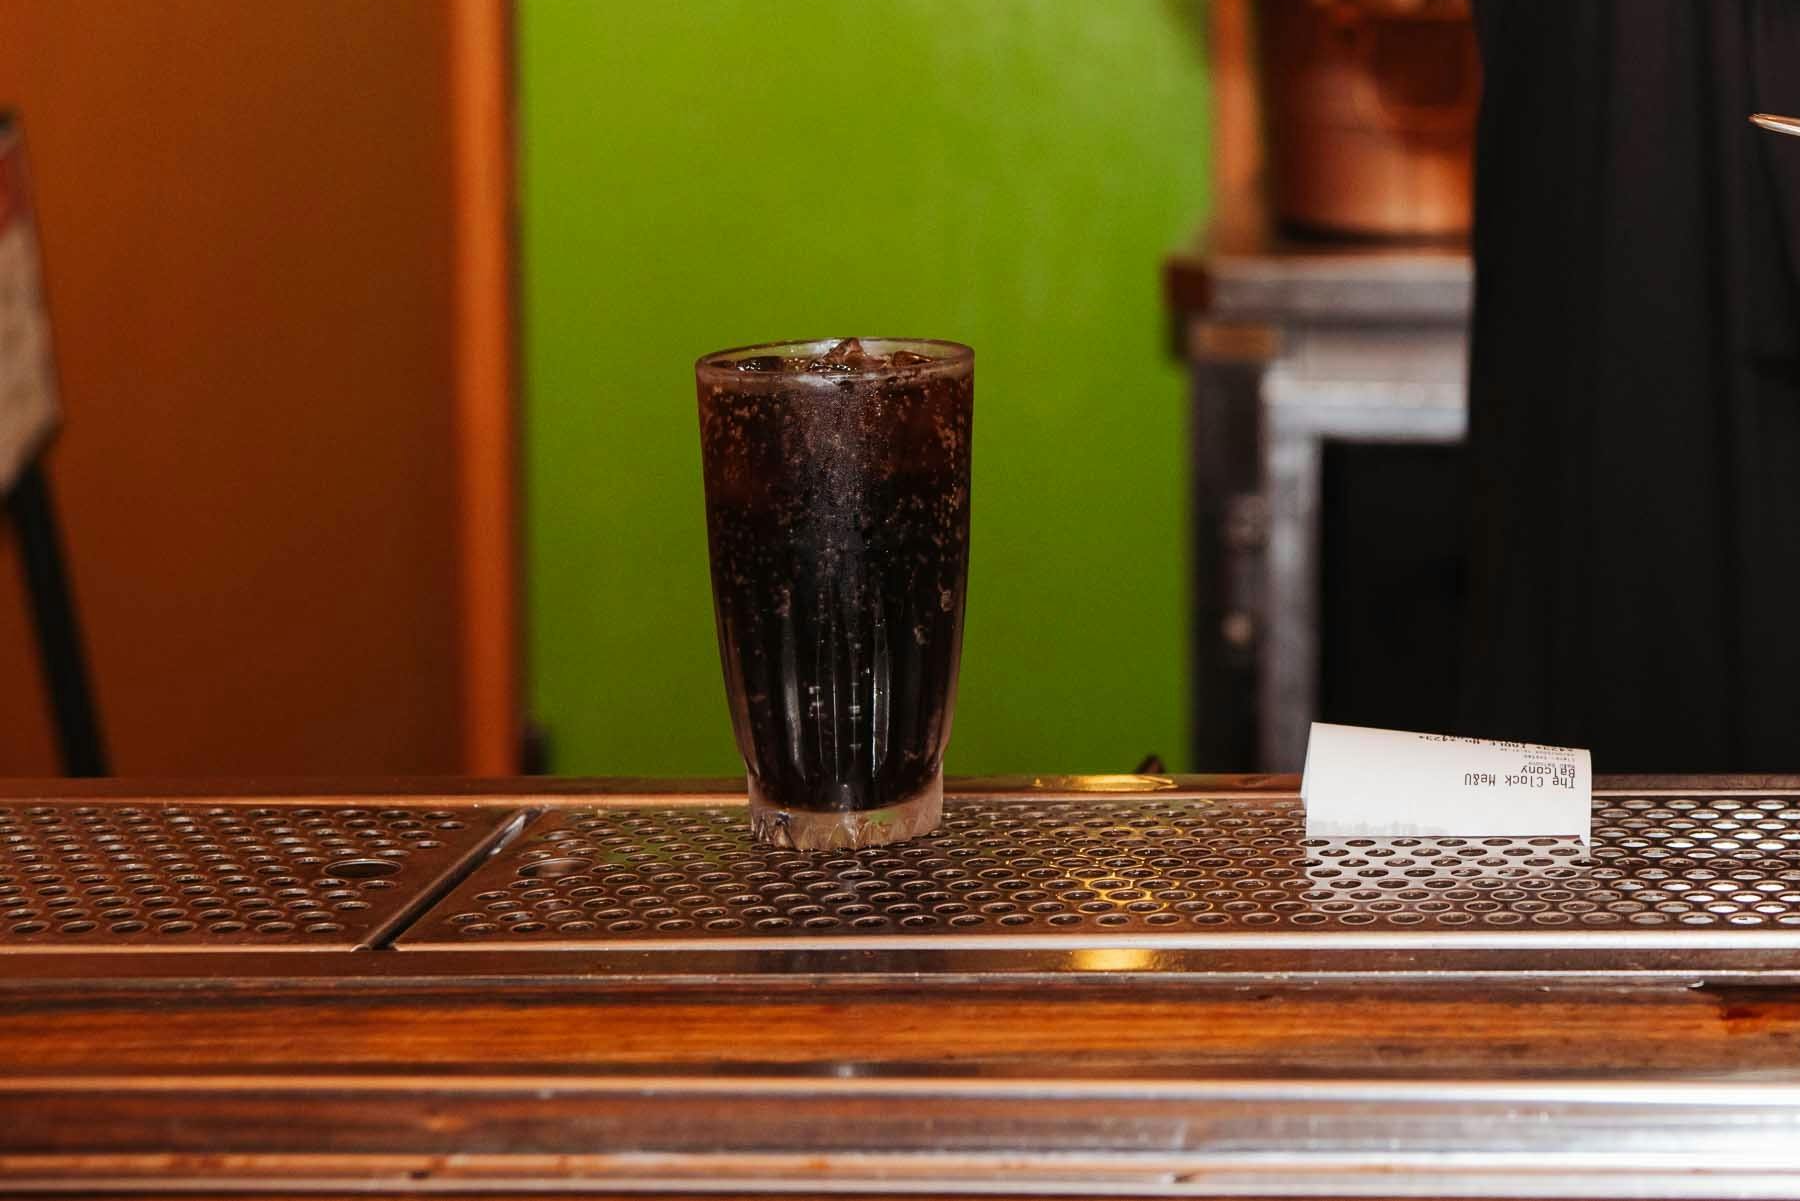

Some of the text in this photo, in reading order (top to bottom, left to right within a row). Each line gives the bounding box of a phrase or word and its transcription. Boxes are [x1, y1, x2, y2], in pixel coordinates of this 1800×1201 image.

[1520, 764, 1576, 779] Balcony
[1463, 773, 1576, 789] The Clock Me&U
